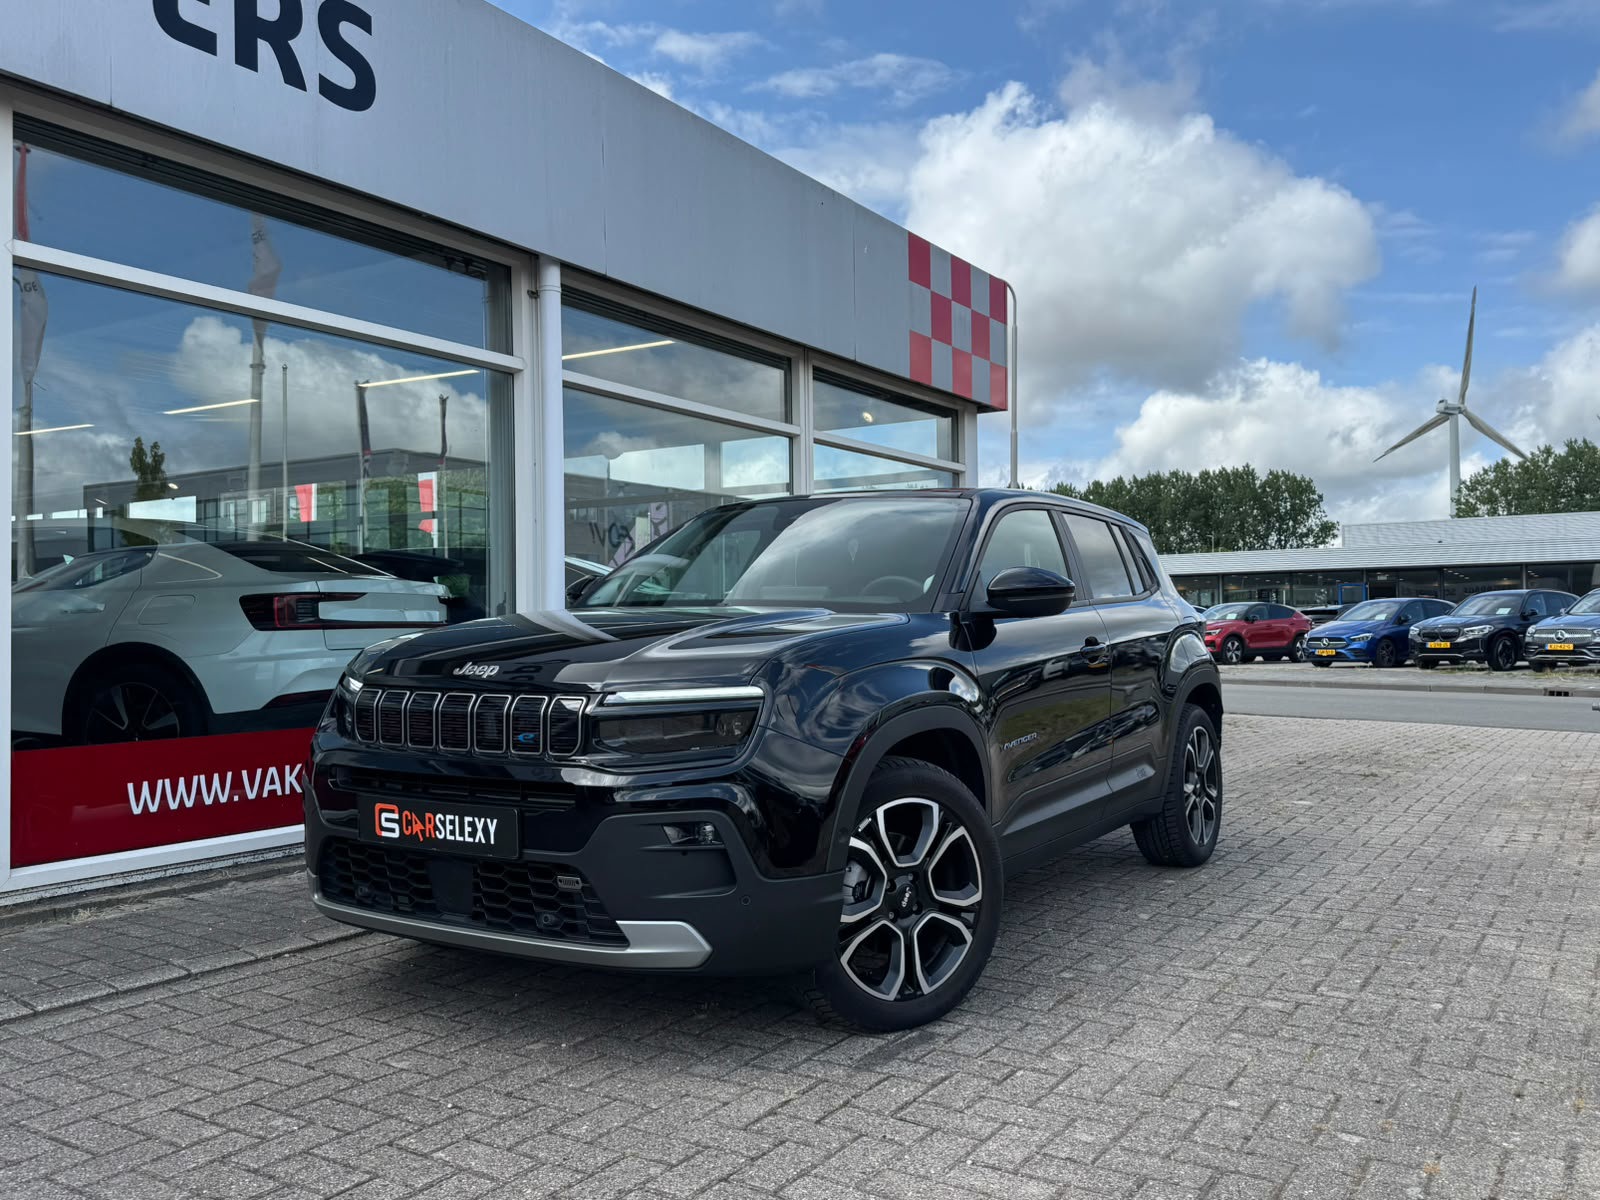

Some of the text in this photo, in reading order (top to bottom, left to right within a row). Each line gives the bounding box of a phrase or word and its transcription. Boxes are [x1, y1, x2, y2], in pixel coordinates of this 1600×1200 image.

[453, 661, 500, 679] Jeep
[127, 763, 303, 815] WWW.VAK
[402, 810, 498, 845] CARSELEXY
